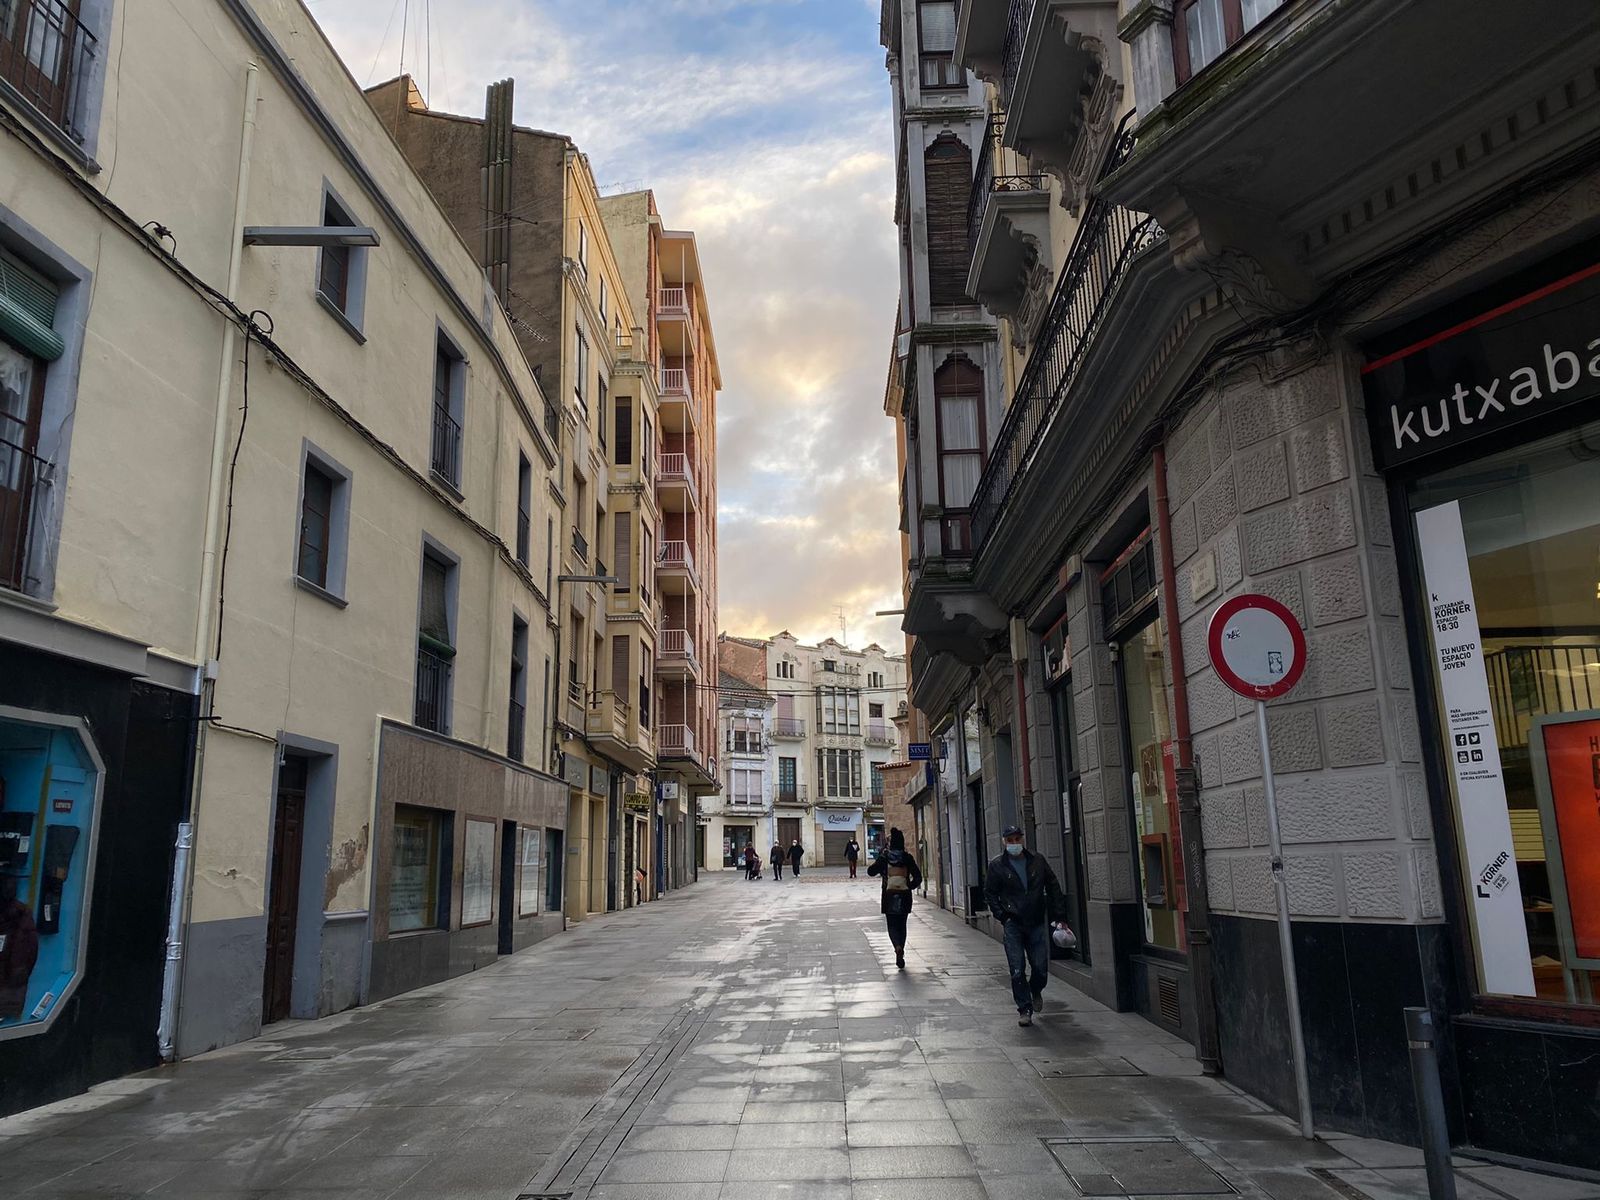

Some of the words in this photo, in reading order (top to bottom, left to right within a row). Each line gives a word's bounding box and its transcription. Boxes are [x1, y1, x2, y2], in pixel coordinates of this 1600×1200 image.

[1435, 604, 1470, 618] KORNER
[1441, 648, 1450, 656] TU
[1451, 643, 1475, 653] NUEVO
[1442, 651, 1472, 663] ESPACIO
[1443, 661, 1465, 670] JOVEN
[1481, 852, 1509, 885] KORNER
